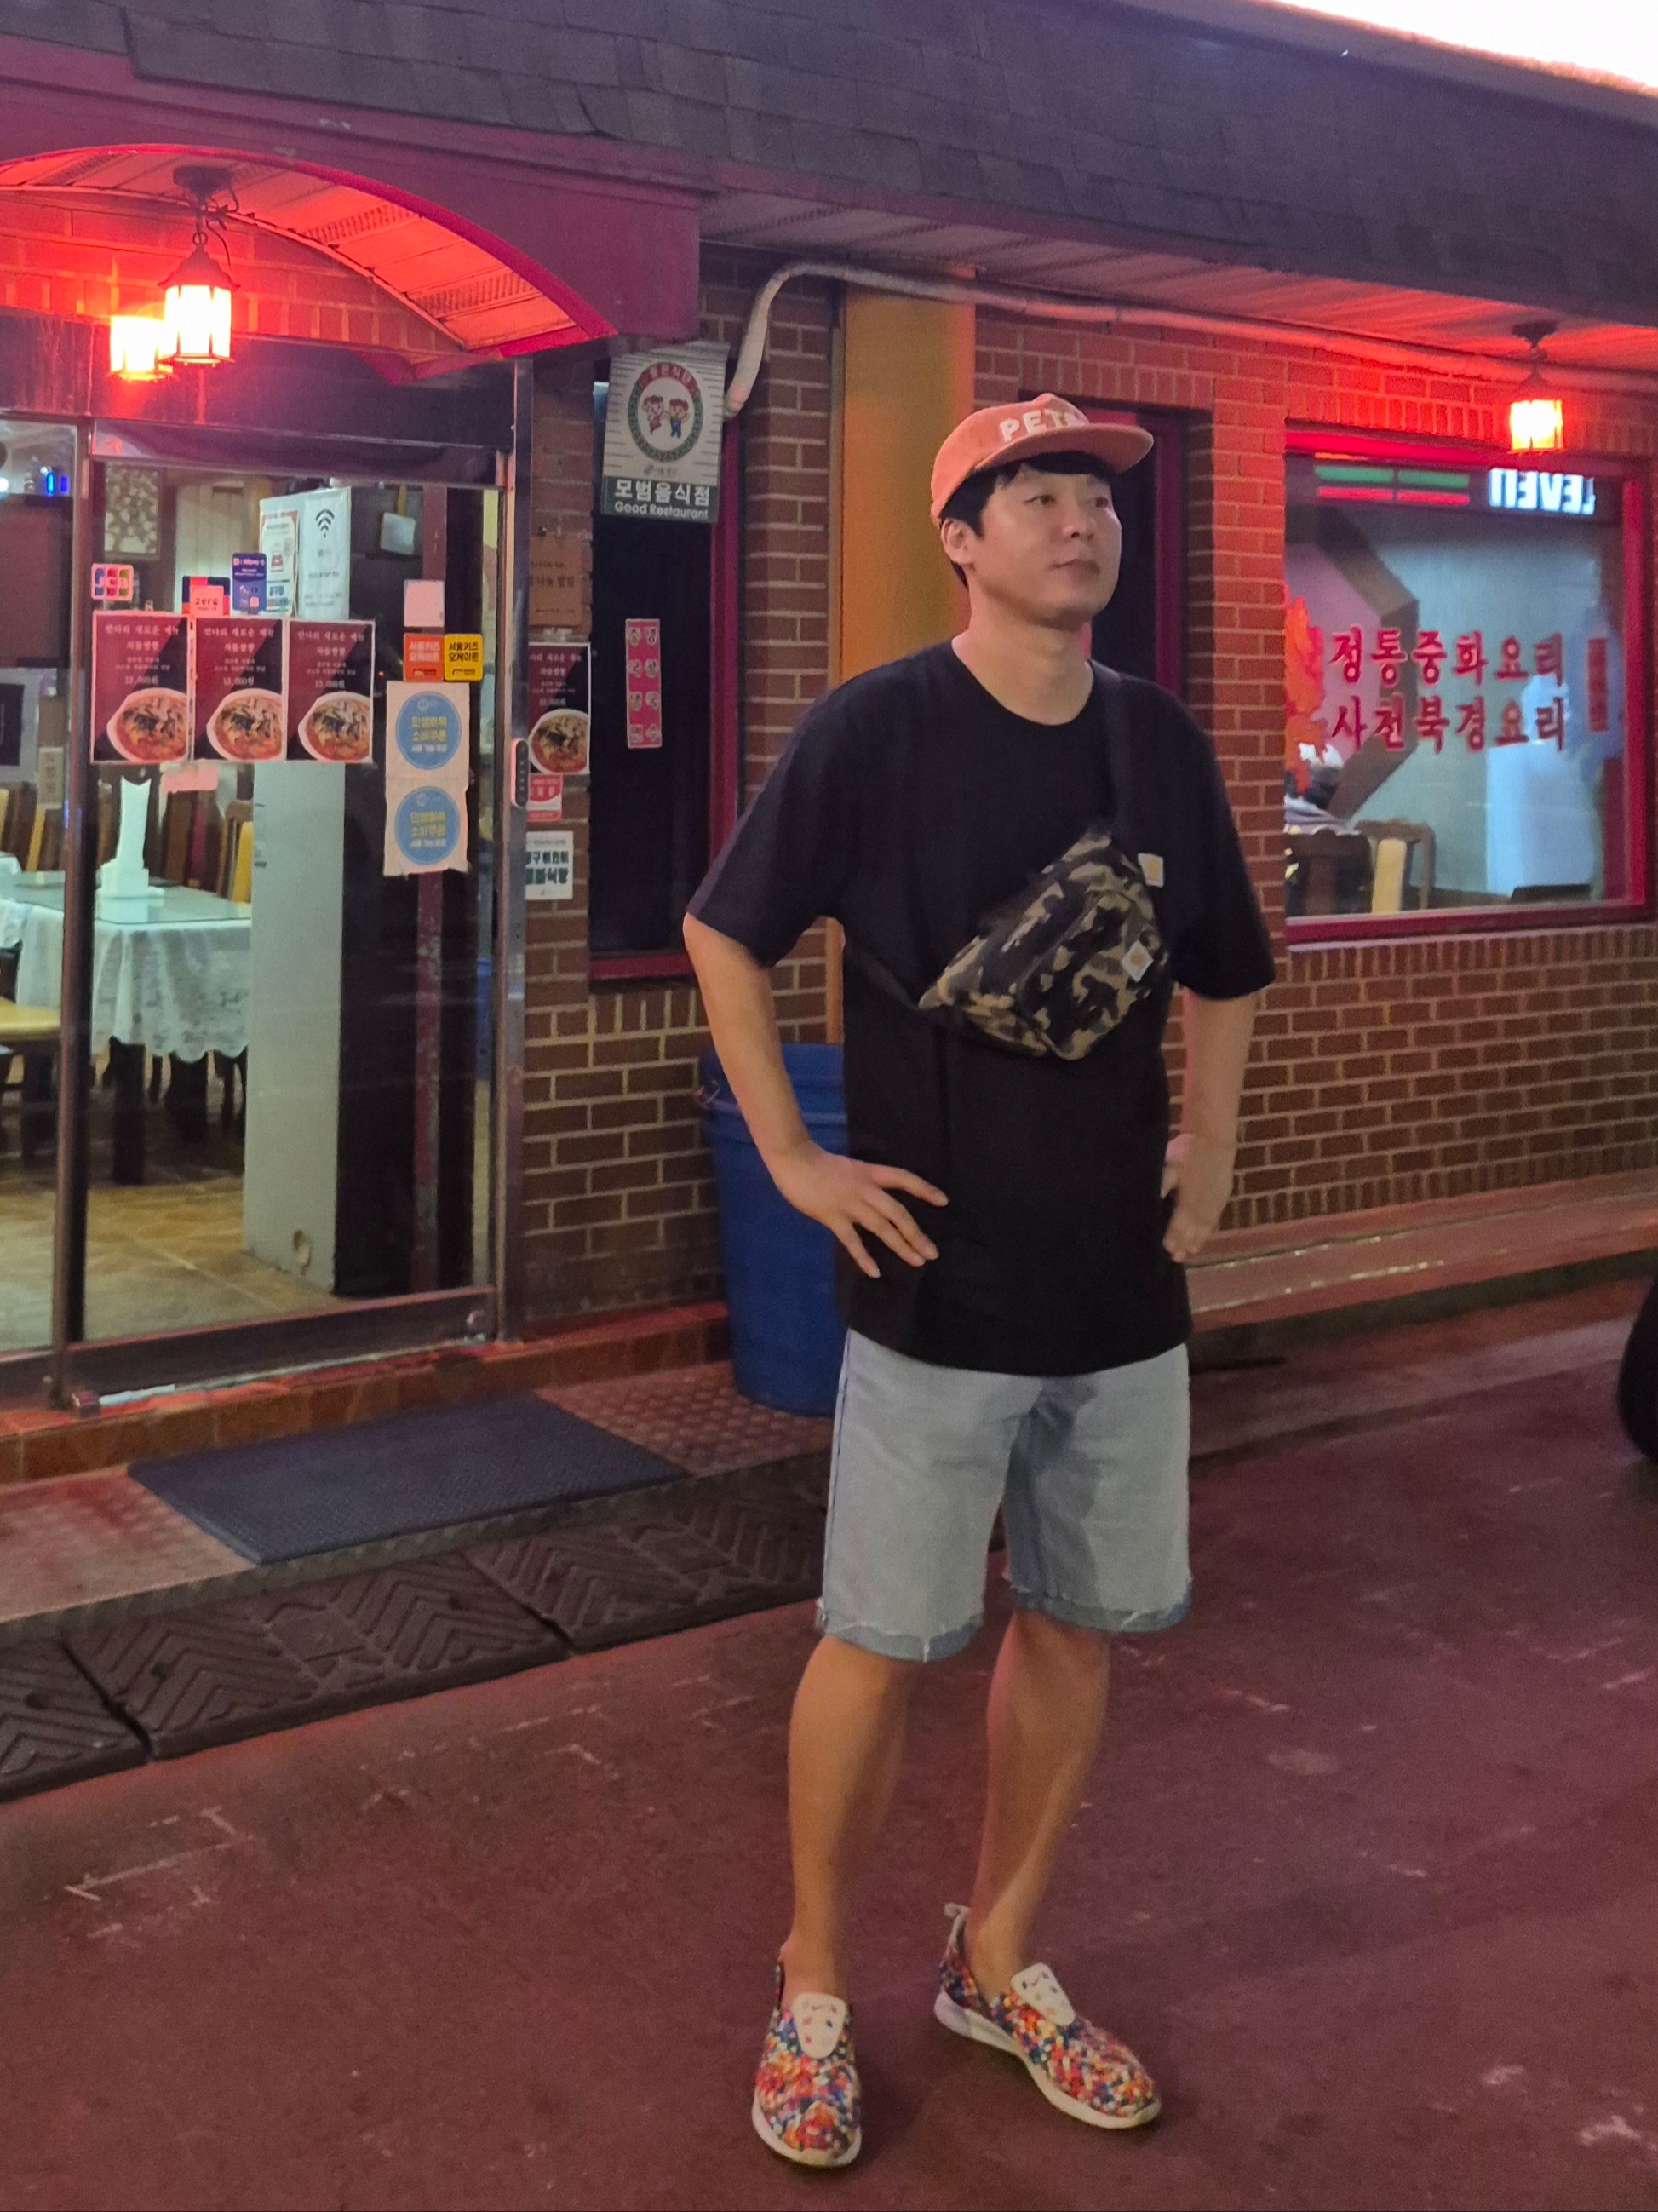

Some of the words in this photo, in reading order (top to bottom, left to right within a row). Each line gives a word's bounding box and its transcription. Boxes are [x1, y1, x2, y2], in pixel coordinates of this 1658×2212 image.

[614, 479, 710, 506] 모범음식점
[614, 501, 648, 515] Good
[650, 503, 709, 520] Restaurant
[449, 641, 479, 651] 서울키즈
[449, 652, 479, 663] 오케이존
[1329, 624, 1564, 688] 정통중화요리
[1332, 694, 1565, 754] 사천북경요리
